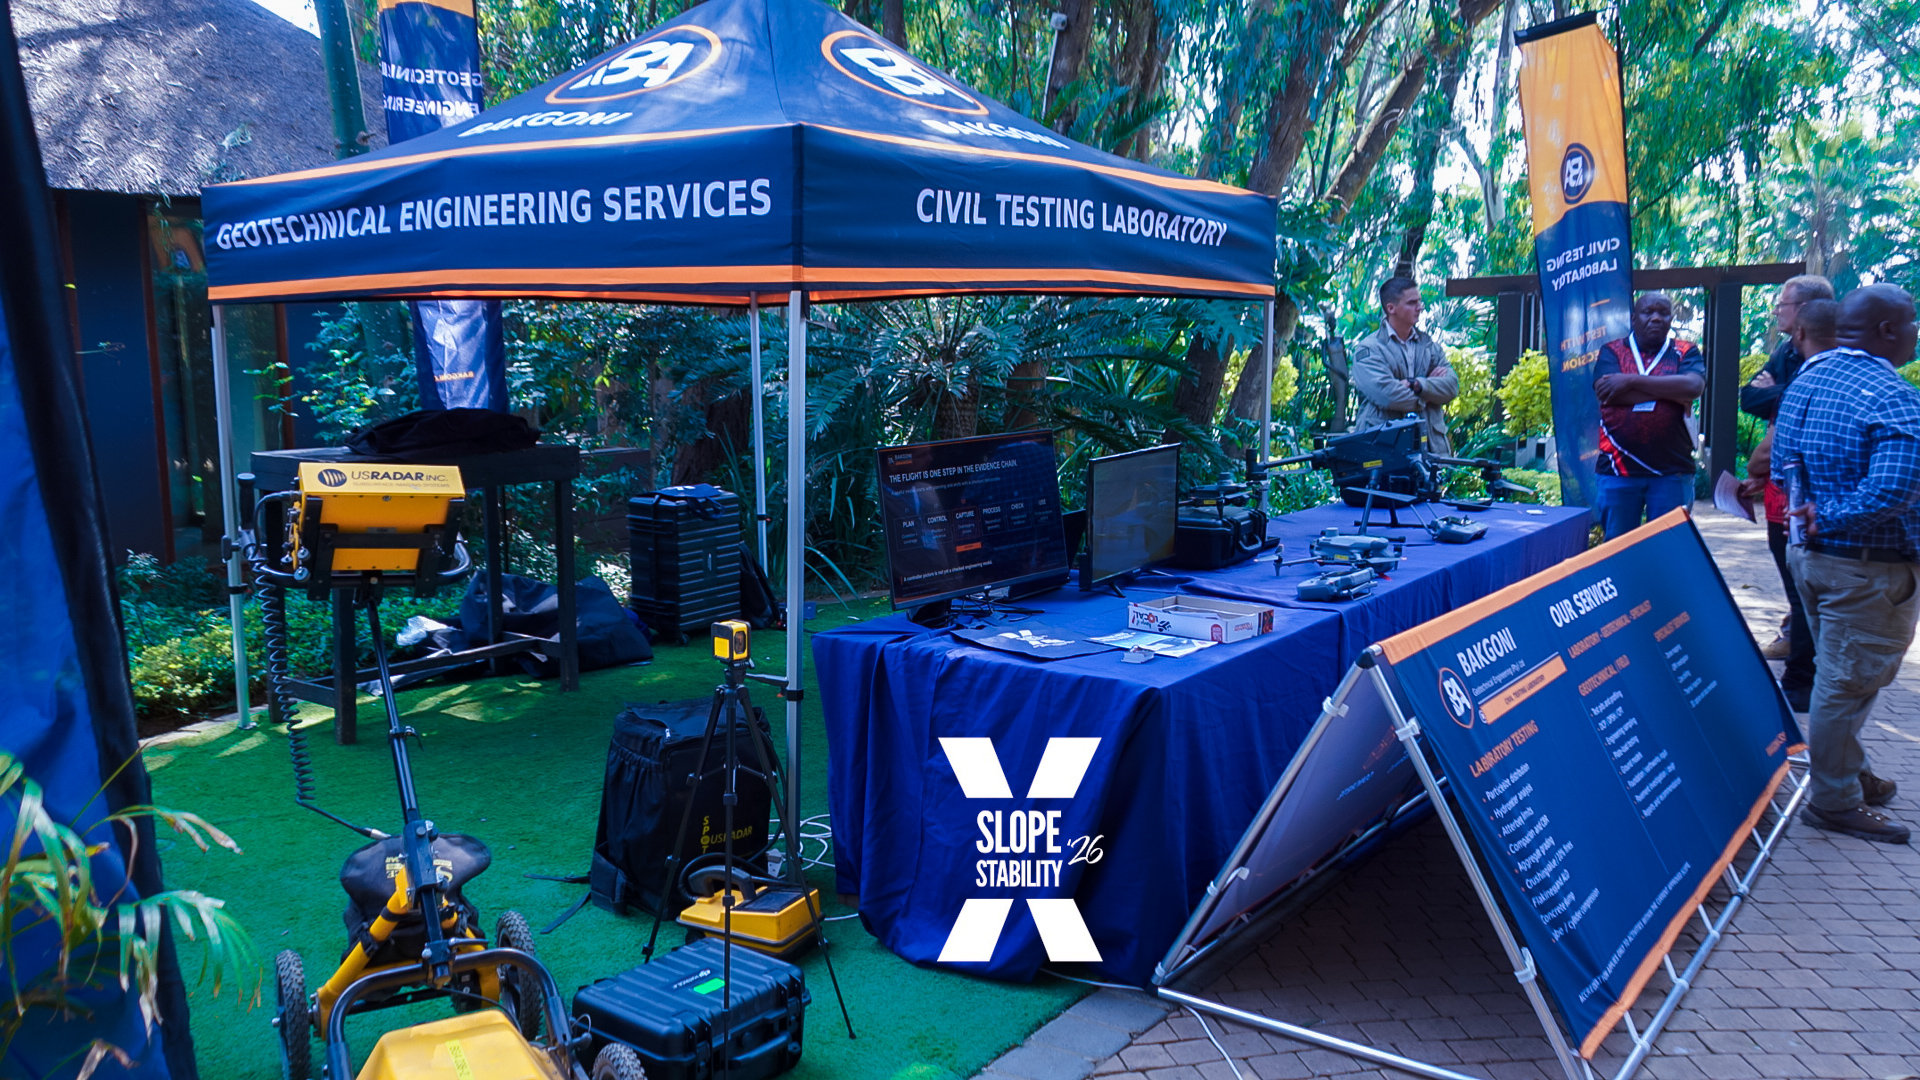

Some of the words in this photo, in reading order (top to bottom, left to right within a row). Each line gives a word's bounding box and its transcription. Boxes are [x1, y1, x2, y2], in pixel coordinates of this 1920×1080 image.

[457, 111, 633, 137] BAKGONI
[921, 119, 1070, 150] BAKGONI
[216, 205, 391, 250] GEOTECHNICAL
[400, 189, 592, 232] ENGINEERING
[603, 178, 772, 222] SERVICES
[916, 188, 987, 225] CIVIL
[995, 193, 1094, 230] TESTING
[1102, 202, 1228, 247] LABORATORY
[425, 474, 448, 482] INC.
[889, 474, 901, 483] THE
[901, 471, 922, 481] FLIGHT
[922, 470, 929, 478] IS
[928, 469, 941, 478] ONE
[942, 467, 956, 476] STEP
[956, 466, 963, 474] IN
[963, 464, 974, 473] THE
[974, 461, 1000, 471] EVIDENCE
[954, 510, 974, 519] CAPTURE
[982, 506, 1001, 514] PROCESS
[1010, 502, 1024, 510] CHECK
[902, 520, 915, 528] PLAN
[926, 514, 947, 523] CONTROL
[1549, 598, 1578, 628] OUR
[1572, 576, 1618, 616] SERVICES
[1456, 626, 1517, 677] BAKGONI
[1568, 632, 1600, 658] LABORATORY
[1510, 720, 1538, 746] TESTING
[710, 825, 753, 844] USADAR
